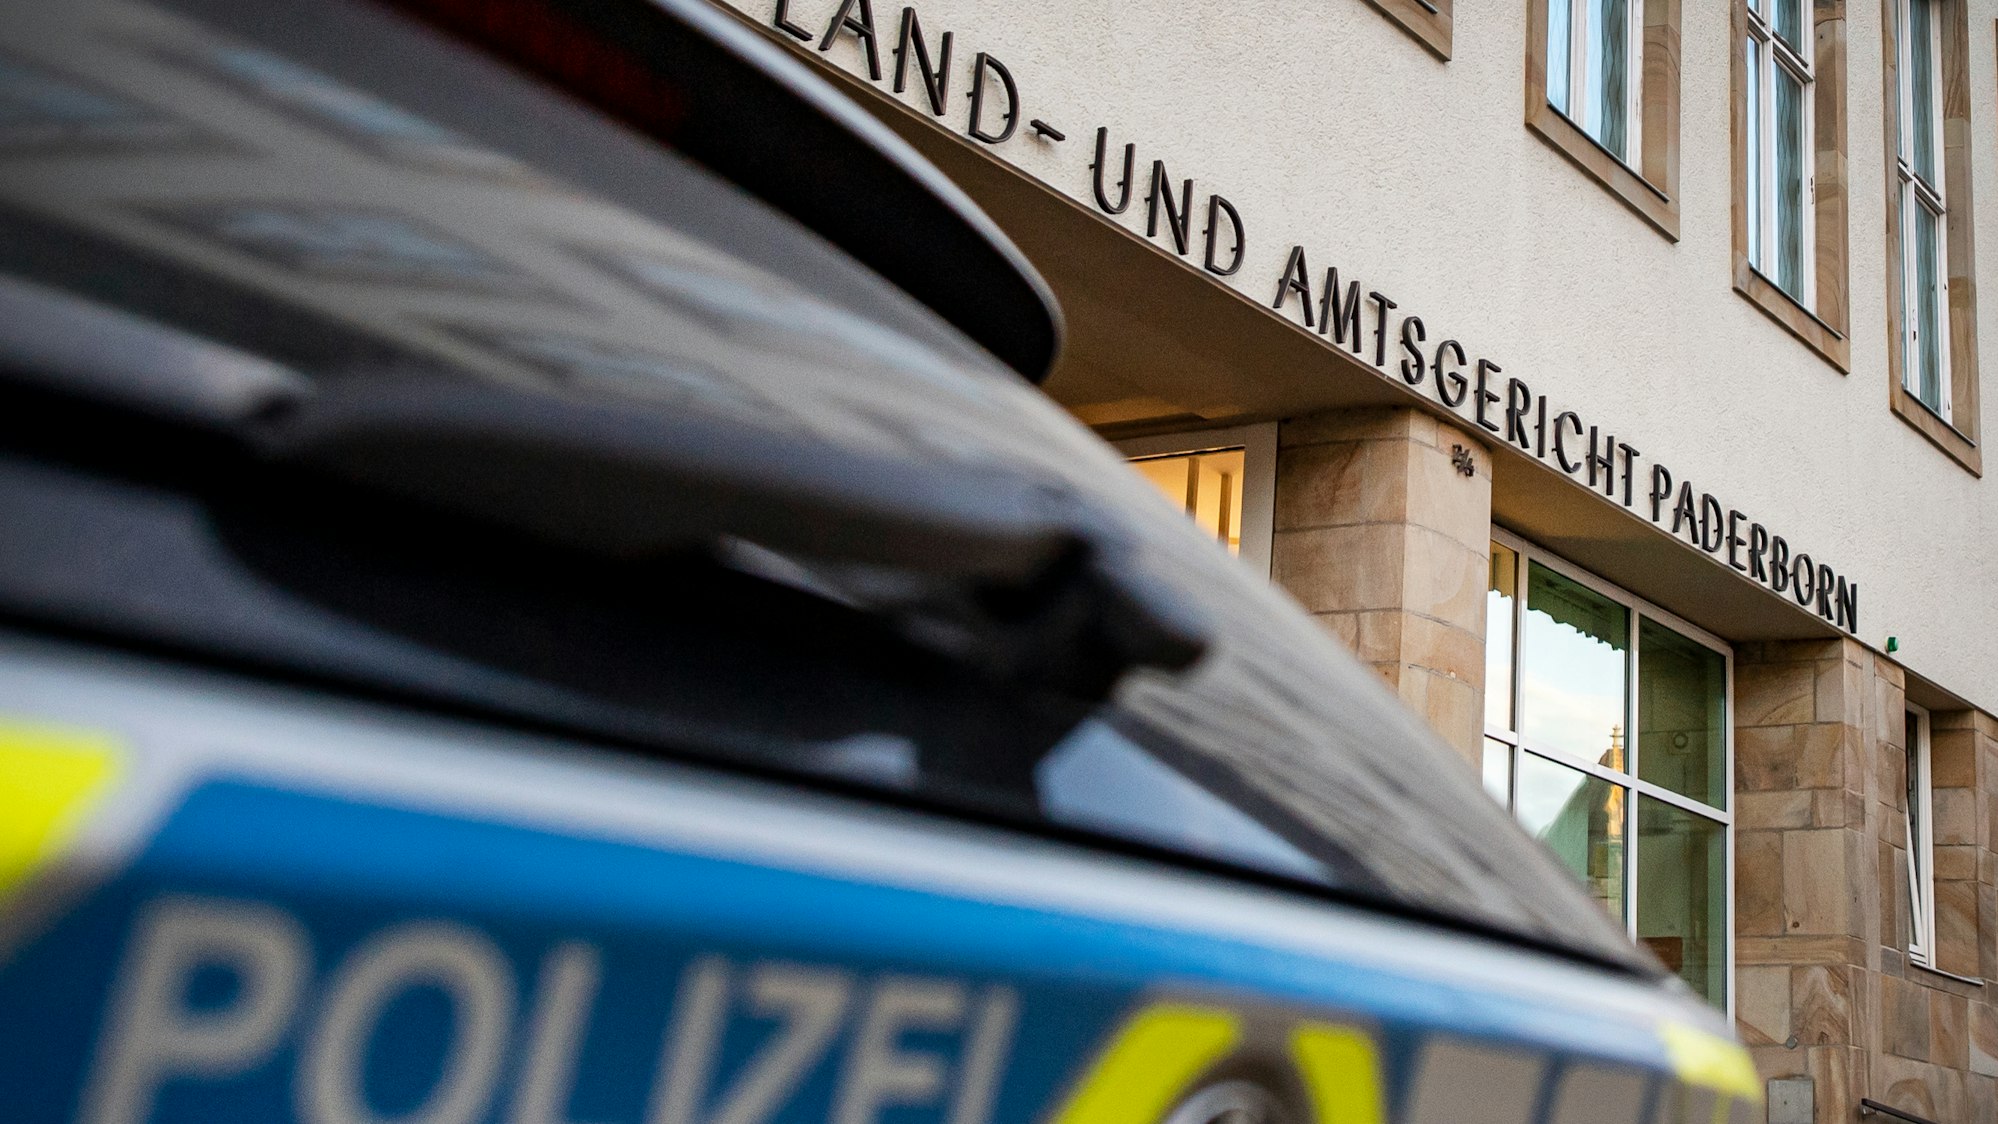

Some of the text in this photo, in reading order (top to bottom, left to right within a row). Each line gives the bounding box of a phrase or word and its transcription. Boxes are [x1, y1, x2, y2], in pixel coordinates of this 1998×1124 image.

[1089, 126, 1246, 276] UND
[1273, 245, 1640, 506] AMTSGERICHT
[1650, 463, 1858, 633] PADERBORN
